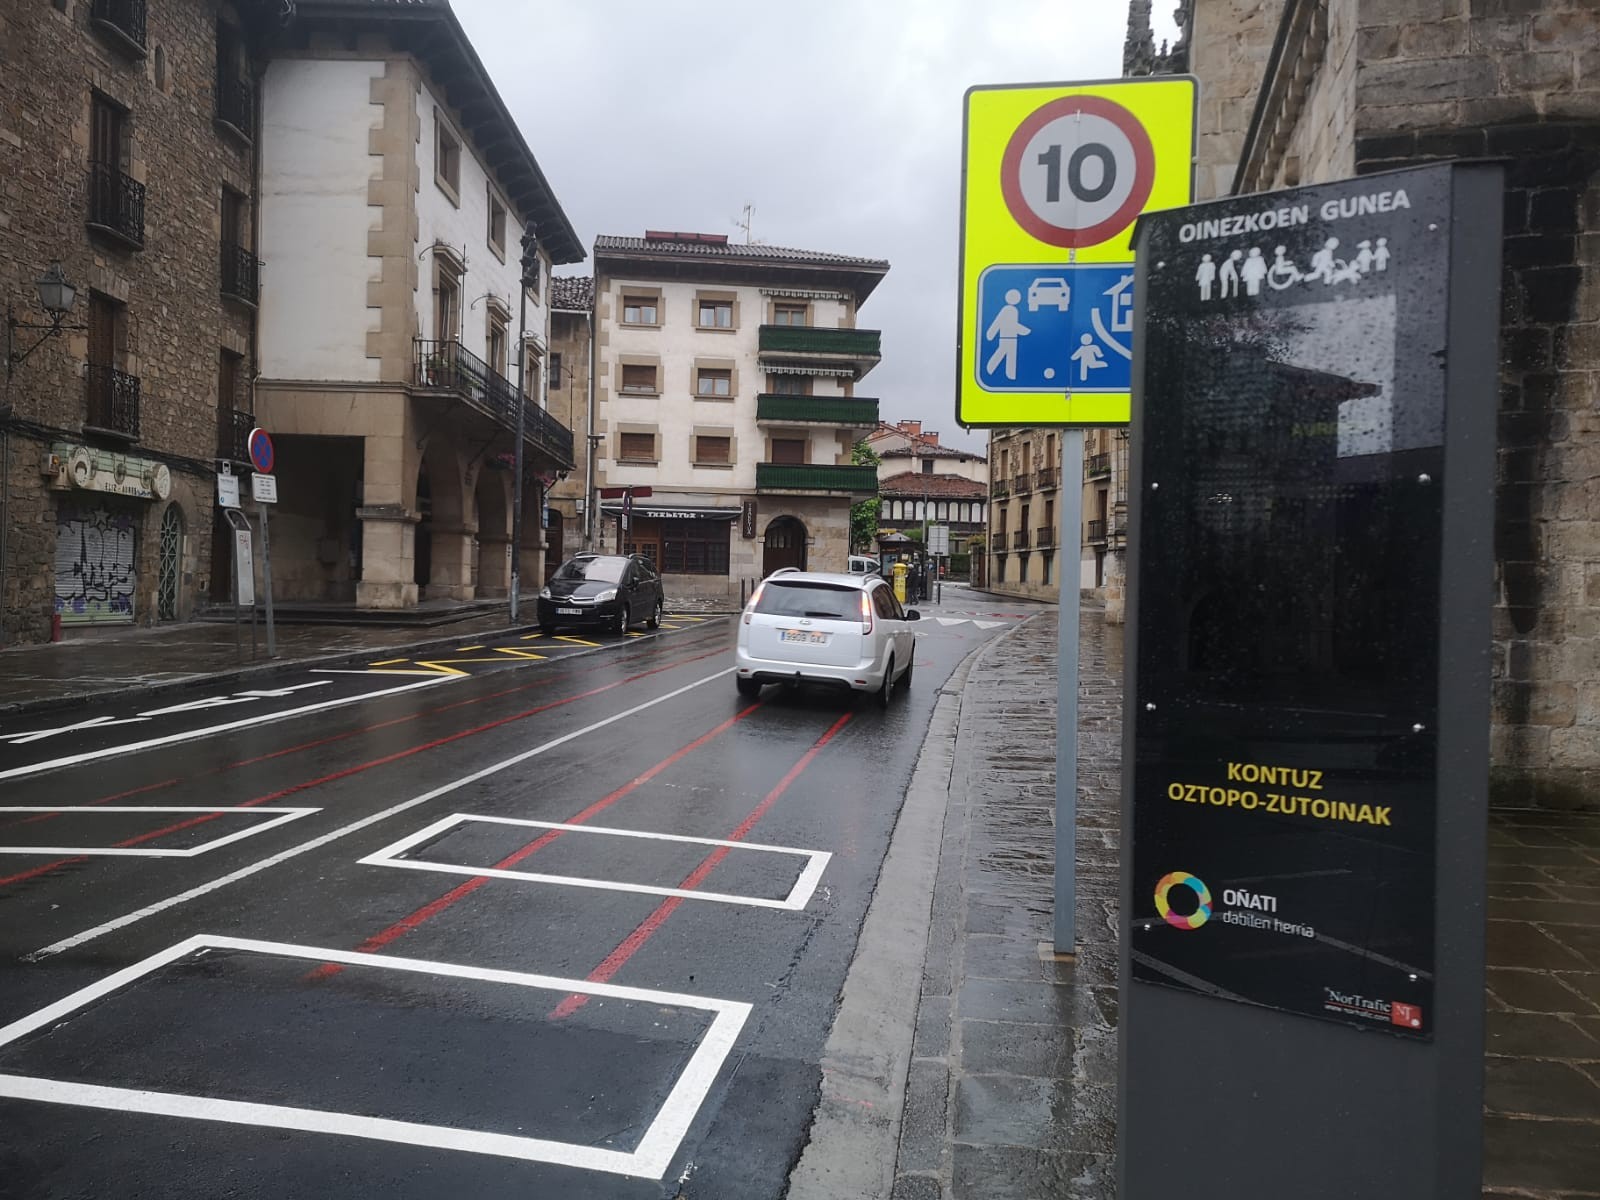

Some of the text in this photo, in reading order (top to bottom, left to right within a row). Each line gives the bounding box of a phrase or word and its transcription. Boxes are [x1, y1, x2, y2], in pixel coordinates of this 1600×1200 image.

[1037, 142, 1117, 203] 10
[1178, 189, 1411, 244] OINEZKOEN GUNEA
[1227, 762, 1324, 790] KONTUZ
[1168, 782, 1392, 826] OZTOPO-ZUTOINAK
[1223, 888, 1277, 912] OÑATI
[1223, 910, 1315, 938] dabilen herria
[1325, 988, 1391, 1012] NorTrafic
